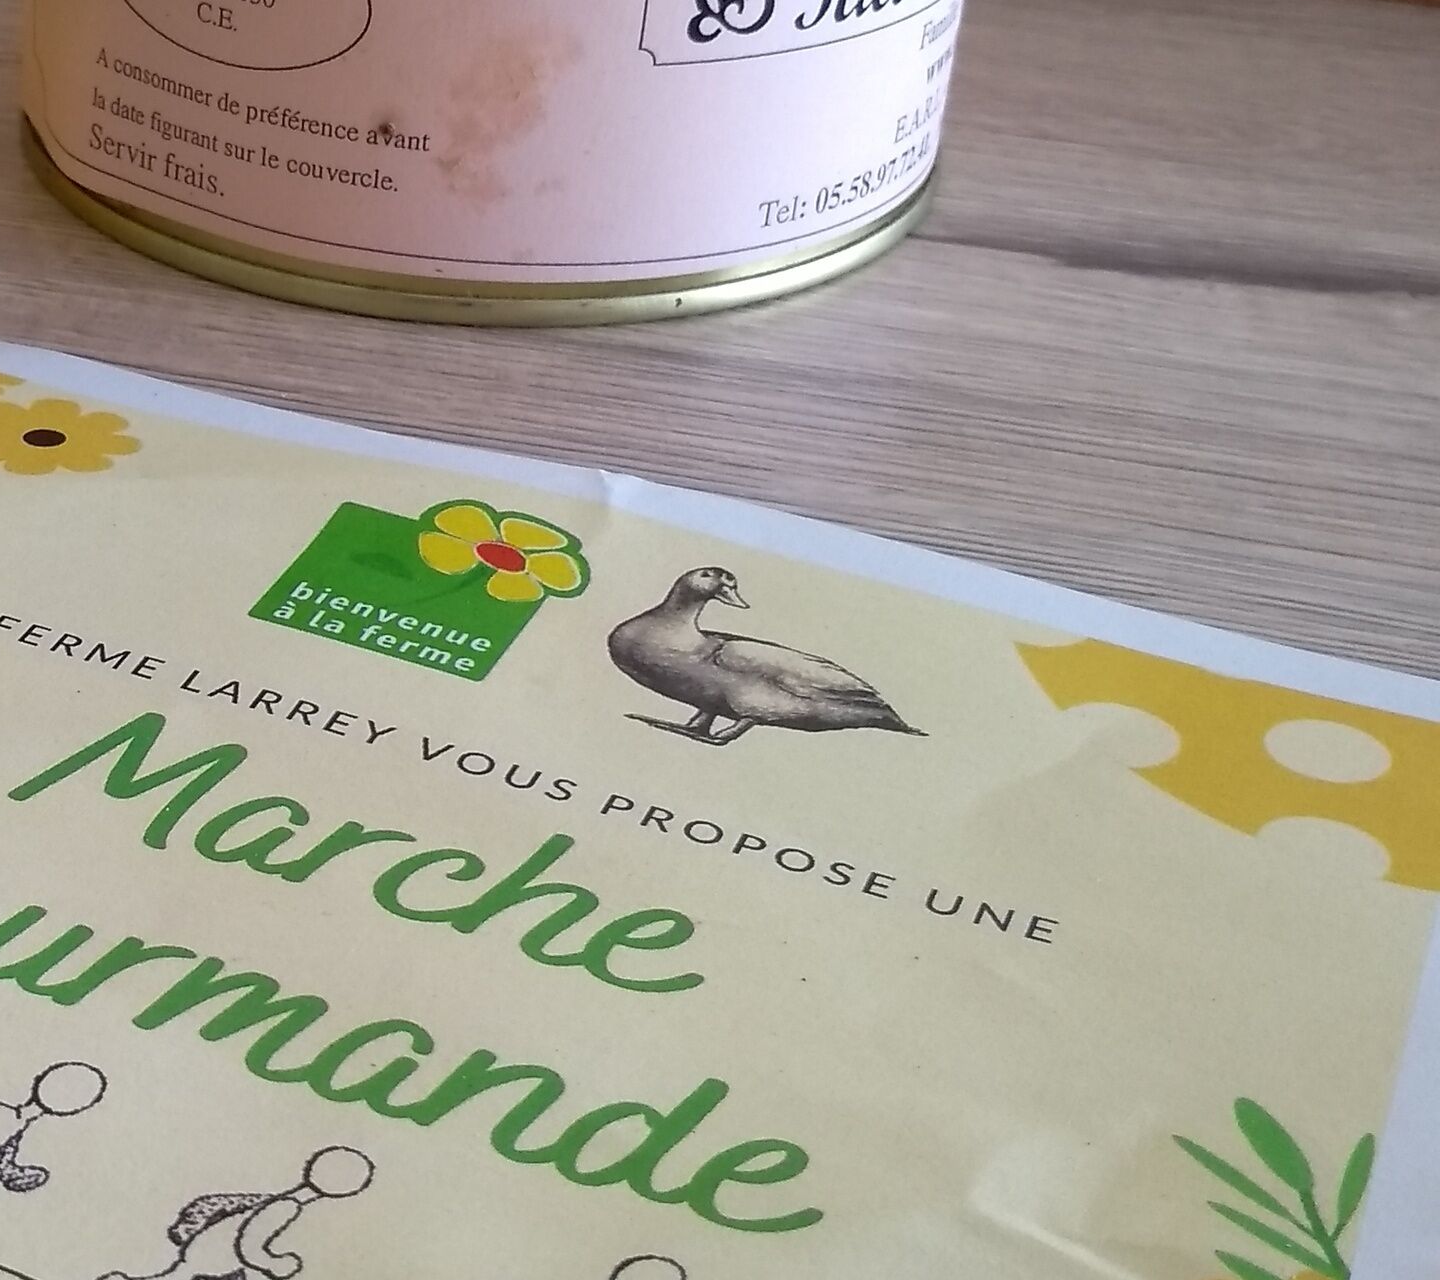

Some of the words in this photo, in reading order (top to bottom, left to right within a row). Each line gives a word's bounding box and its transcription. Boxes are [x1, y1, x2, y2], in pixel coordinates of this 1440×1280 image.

[196, 1, 238, 32] C.E.
[95, 47, 111, 69] A
[113, 56, 213, 108] consommer
[217, 91, 241, 115] de
[246, 103, 359, 143] préférence
[365, 127, 431, 152] avant
[88, 123, 158, 172] Servir
[163, 152, 226, 198] frais.
[92, 87, 107, 110] la
[110, 95, 145, 125] date
[150, 107, 219, 153] figurant
[223, 140, 257, 165] sur
[260, 146, 280, 170] le
[286, 155, 399, 193] couvercle.
[758, 198, 808, 229] Tel:
[272, 601, 298, 621] à
[309, 609, 346, 635] la
[360, 624, 477, 673] ferme
[290, 581, 492, 653] bienvenue
[179, 668, 398, 747] LARREY
[420, 736, 579, 804] VOUS
[599, 792, 898, 900] PROPOSE
[923, 887, 1061, 945] UNE
[6, 710, 706, 995] Marche
